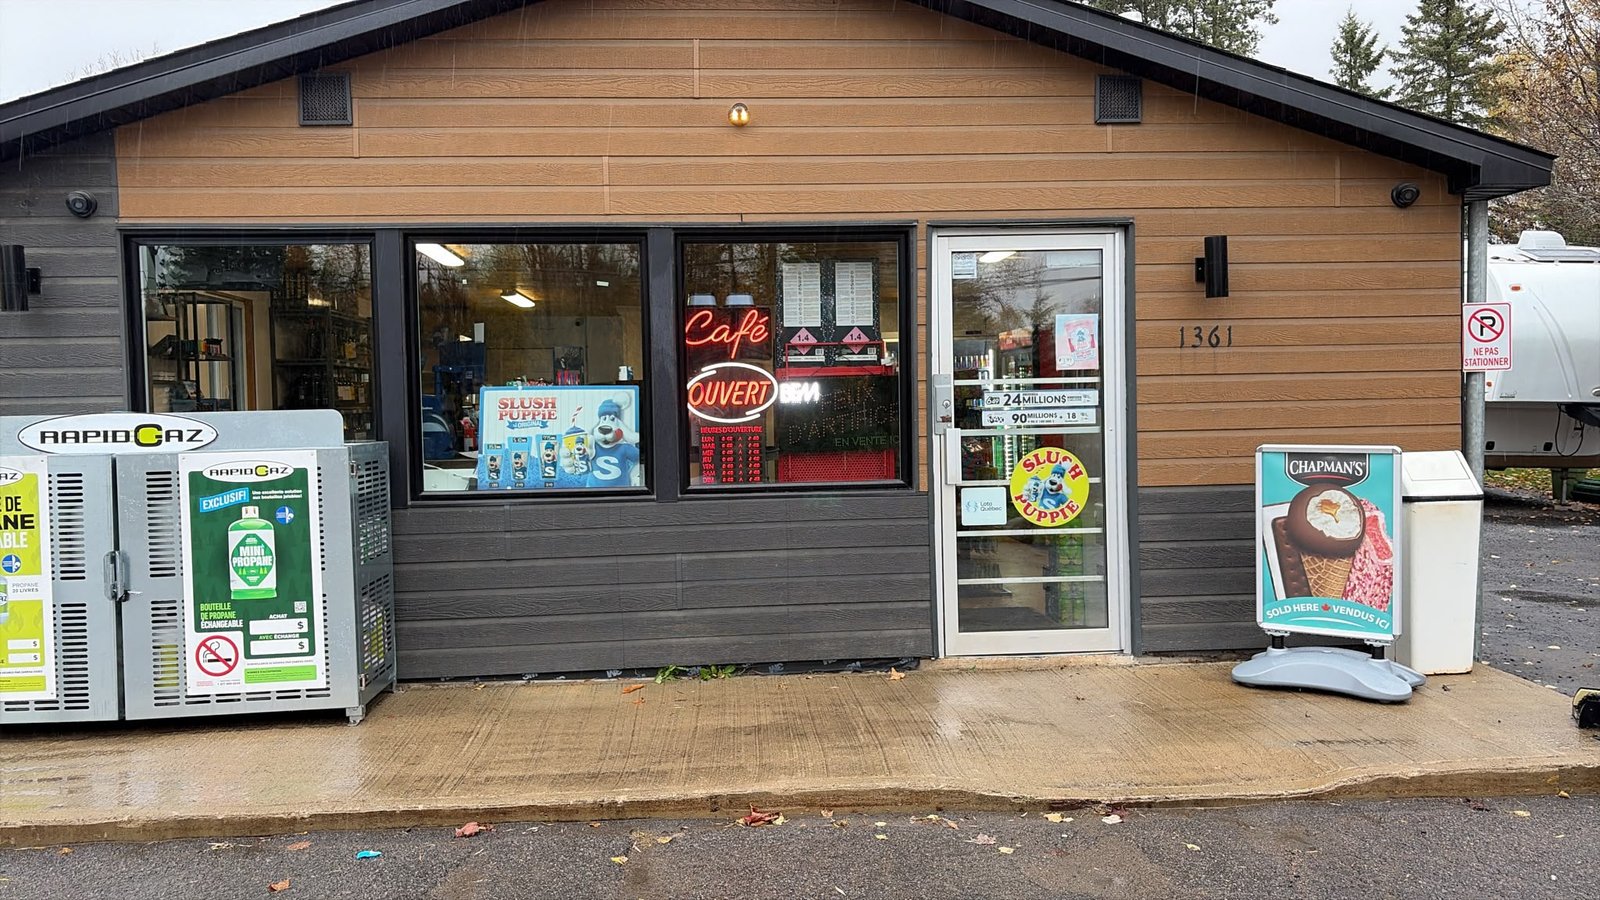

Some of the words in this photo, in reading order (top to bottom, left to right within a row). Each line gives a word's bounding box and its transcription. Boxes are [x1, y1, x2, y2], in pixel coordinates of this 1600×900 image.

[686, 310, 768, 359] Café
[850, 333, 861, 341] 1.4
[1180, 325, 1232, 348] 1361
[1473, 348, 1483, 356] NE
[1484, 347, 1499, 355] PAS
[1464, 358, 1509, 367] STATIONNER
[689, 381, 771, 406] OUVERT
[498, 397, 557, 409] SLUSH
[1003, 394, 1022, 406] 24
[1012, 414, 1027, 424] 90
[40, 424, 203, 447] RAPIDGAZ
[835, 438, 848, 446] EN
[853, 436, 886, 446] VENTE
[209, 465, 289, 477] RAPIDGAZ
[1289, 460, 1363, 476] CHAPMAN'S
[5, 496, 22, 511] DE
[0, 514, 35, 530] NE
[232, 555, 273, 567] PROPANE
[200, 603, 231, 611] BOUTEILLE
[201, 612, 209, 620] DE
[209, 611, 236, 619] PROPANE
[1266, 604, 1291, 619] SOLD
[1293, 603, 1319, 612] HERE
[1332, 605, 1375, 622] VENDUS
[1375, 617, 1390, 629] ICI
[201, 620, 244, 629] ÉCHANGEABLE
[297, 621, 304, 630] $
[298, 641, 305, 650] $
